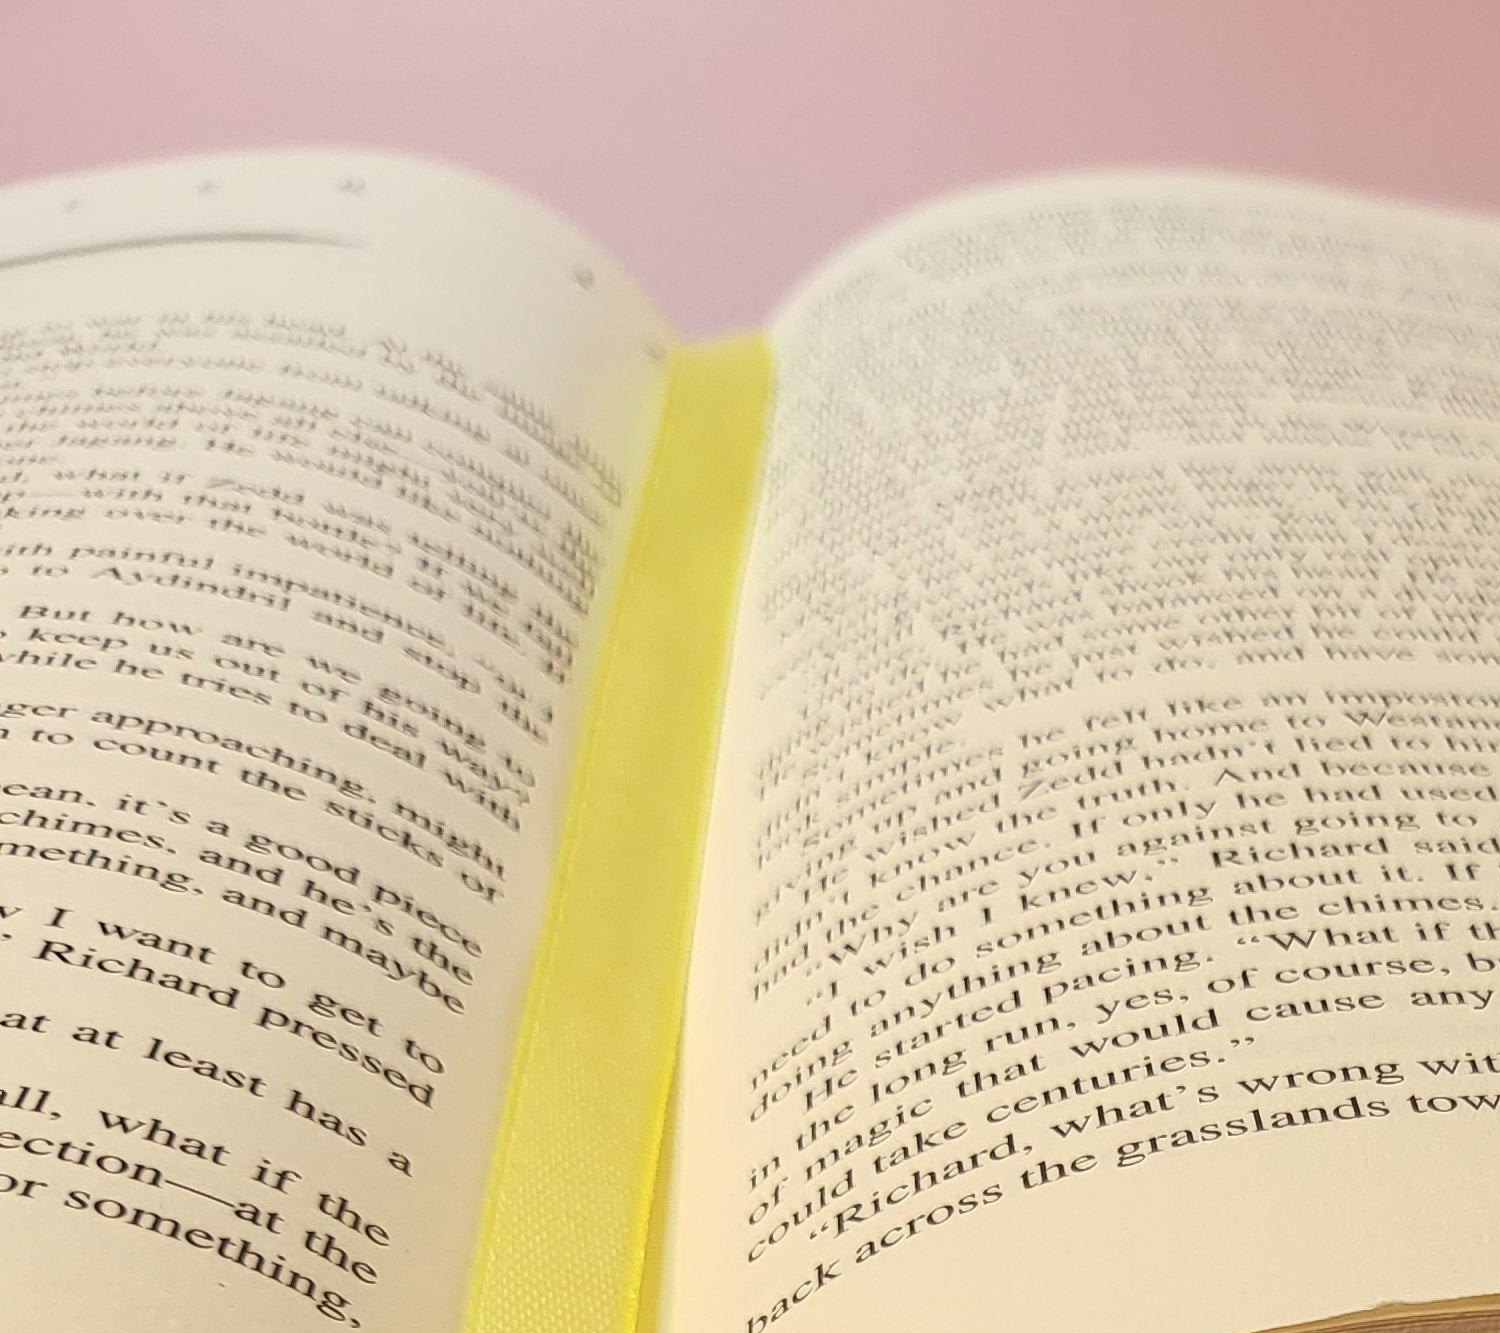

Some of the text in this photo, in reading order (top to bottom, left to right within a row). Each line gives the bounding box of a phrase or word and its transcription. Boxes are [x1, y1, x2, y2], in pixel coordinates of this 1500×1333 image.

[30, 729, 444, 868] to count the sticks
[197, 849, 285, 886] and
[411, 936, 474, 986] the
[204, 820, 231, 837] a
[243, 833, 362, 885] good
[372, 884, 483, 958] piece
[220, 889, 309, 929] and
[320, 925, 466, 1015] maybe
[33, 939, 436, 1108] Richard pressed
[48, 907, 446, 1074] I want to get to
[748, 1040, 854, 1123] doing
[869, 952, 1062, 1038] anything
[1080, 914, 1206, 956] about
[1227, 904, 1298, 925] the
[750, 1014, 832, 1090] need
[848, 989, 888, 1016] to
[903, 956, 957, 986] do
[975, 887, 1209, 953] something
[1232, 868, 1357, 895] about
[1444, 863, 1477, 881] If
[804, 1069, 858, 1111] He
[874, 989, 1022, 1069] started
[1414, 922, 1445, 941] if
[0, 1013, 413, 1178] at at least has a
[747, 1177, 789, 1226] of
[804, 1098, 933, 1181] magic
[955, 1054, 1041, 1098] that
[1069, 1007, 1220, 1058] would
[1244, 994, 1386, 1022] cause
[1409, 989, 1495, 1010] any
[749, 1155, 781, 1190] in
[794, 1104, 855, 1151] the
[870, 1050, 968, 1103] long
[984, 1017, 1077, 1052] run,
[1095, 988, 1190, 1024] yes,
[1206, 969, 1252, 993] of
[1273, 959, 1451, 984] course,
[1236, 1062, 1406, 1094] wrong
[0, 1085, 391, 1247] ll, what if the
[746, 1168, 855, 1263] could
[872, 1121, 967, 1174] take
[854, 1183, 1004, 1264] across
[1019, 1154, 1098, 1190] the
[1115, 1096, 1392, 1168] grasslands
[62, 1190, 362, 1329] something,
[303, 1230, 379, 1285] the
